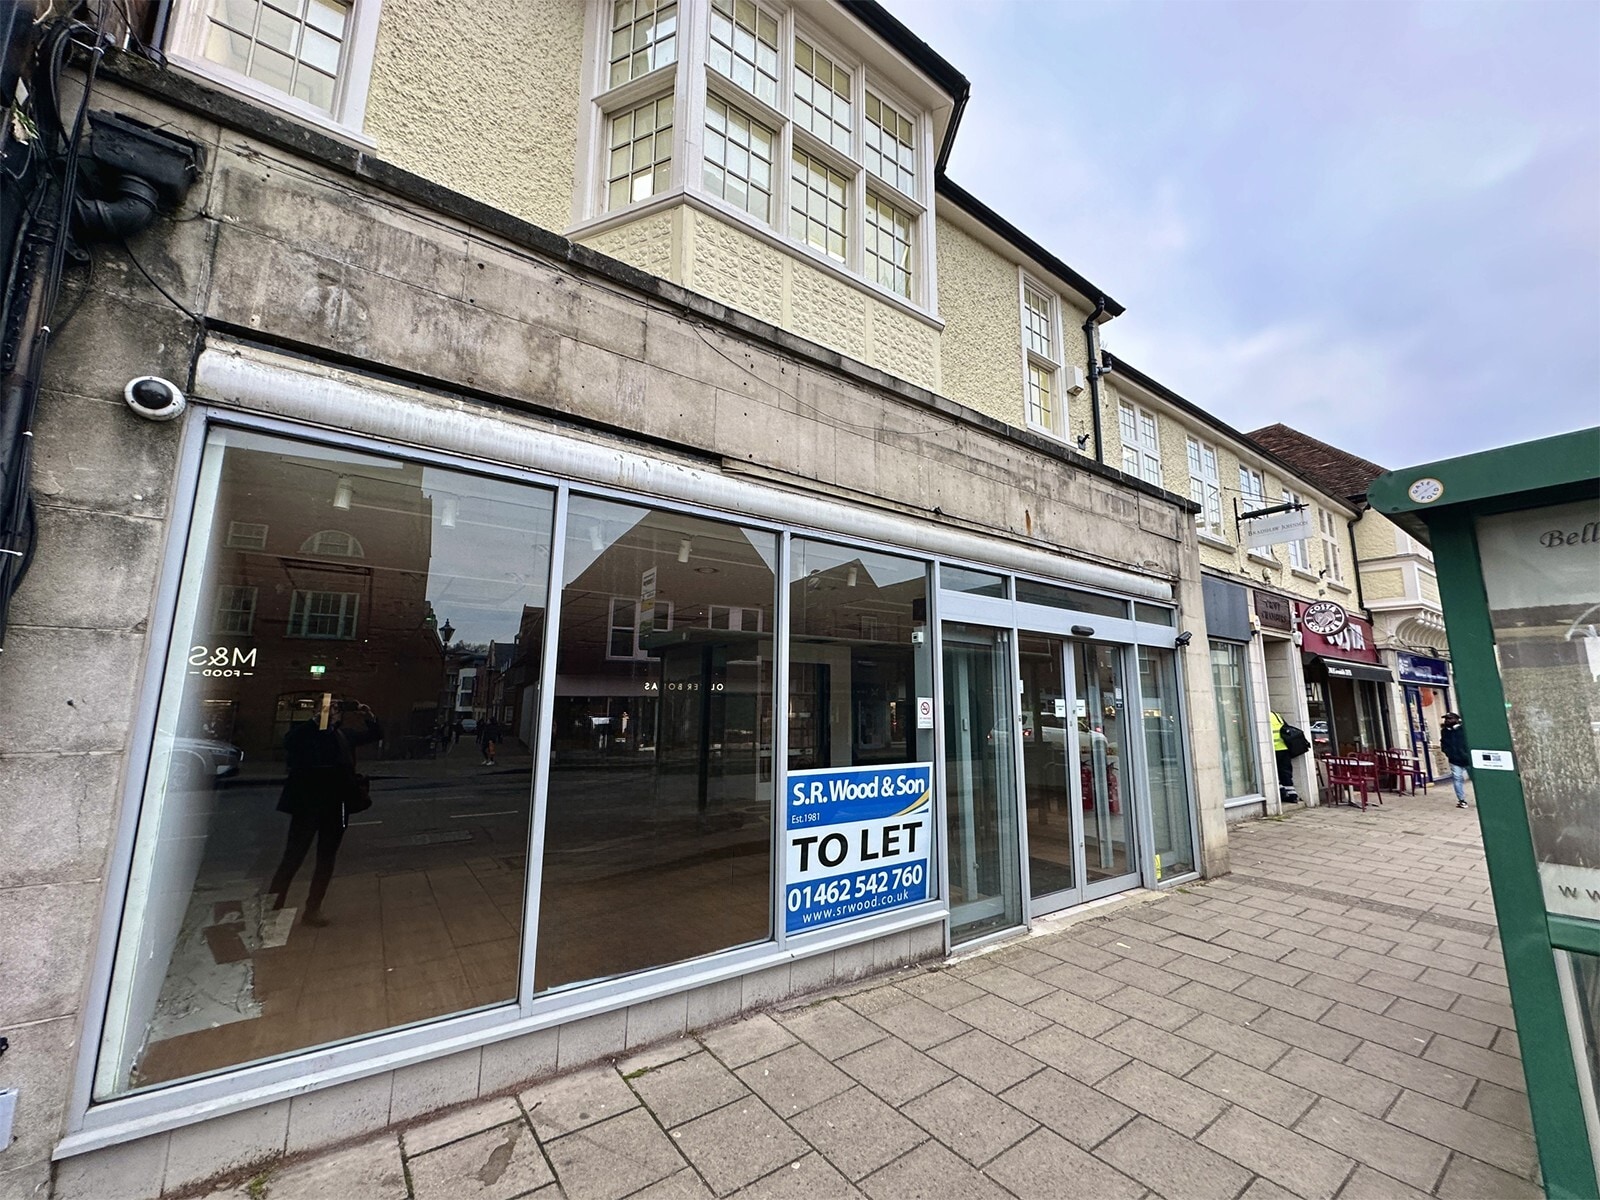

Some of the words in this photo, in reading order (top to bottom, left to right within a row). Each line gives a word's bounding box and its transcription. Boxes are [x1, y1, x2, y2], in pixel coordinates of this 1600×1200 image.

[1309, 604, 1337, 615] COSTA
[1308, 620, 1343, 634] COFFEE
[792, 782, 827, 806] S.R.
[829, 776, 879, 801] Wood
[881, 776, 894, 796] &
[896, 775, 925, 795] Son
[792, 833, 848, 872] TO
[861, 821, 923, 862] LET
[788, 879, 851, 912] 01462
[855, 871, 888, 898] 542
[892, 864, 923, 888] 760
[803, 889, 909, 923] www.srwood.co.uk
